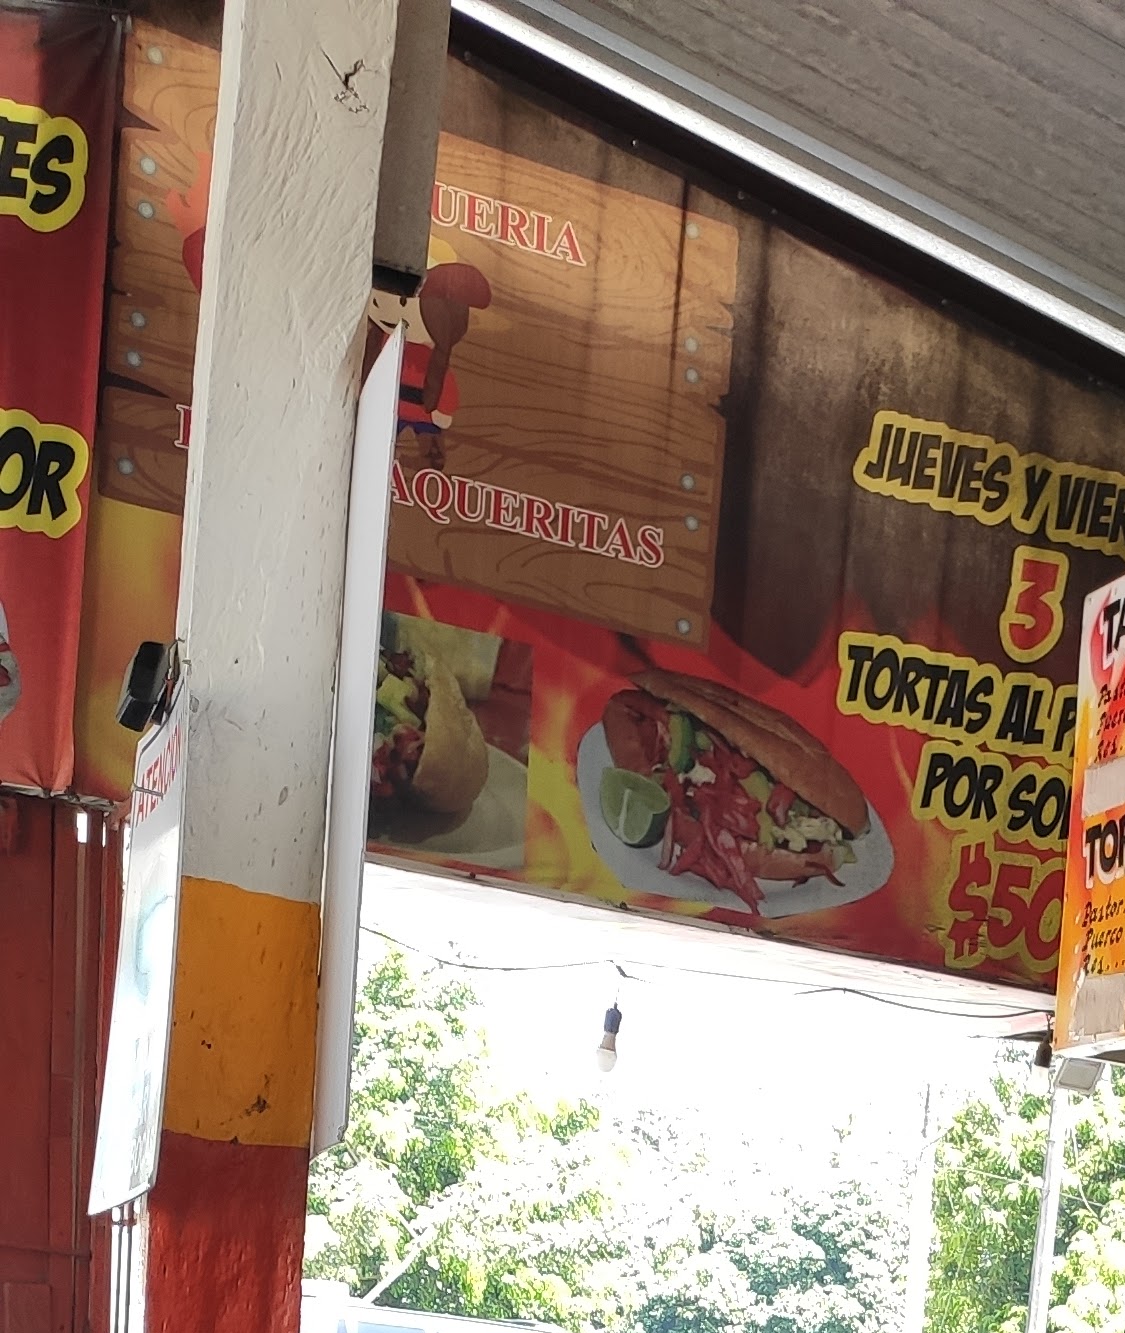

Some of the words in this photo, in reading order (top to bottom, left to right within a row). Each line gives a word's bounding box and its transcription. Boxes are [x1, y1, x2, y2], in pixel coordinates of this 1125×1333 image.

[865, 423, 1012, 515] JUEVES
[1021, 464, 1053, 519] Y
[1012, 560, 1063, 650] 3
[845, 645, 995, 733] TORTAS
[995, 685, 1044, 745] AL
[1053, 697, 1076, 757] P
[921, 753, 1003, 821] POR
[949, 842, 1064, 961] $50
[1082, 895, 1124, 927] Pastor
[1082, 927, 1124, 952] Puerco
